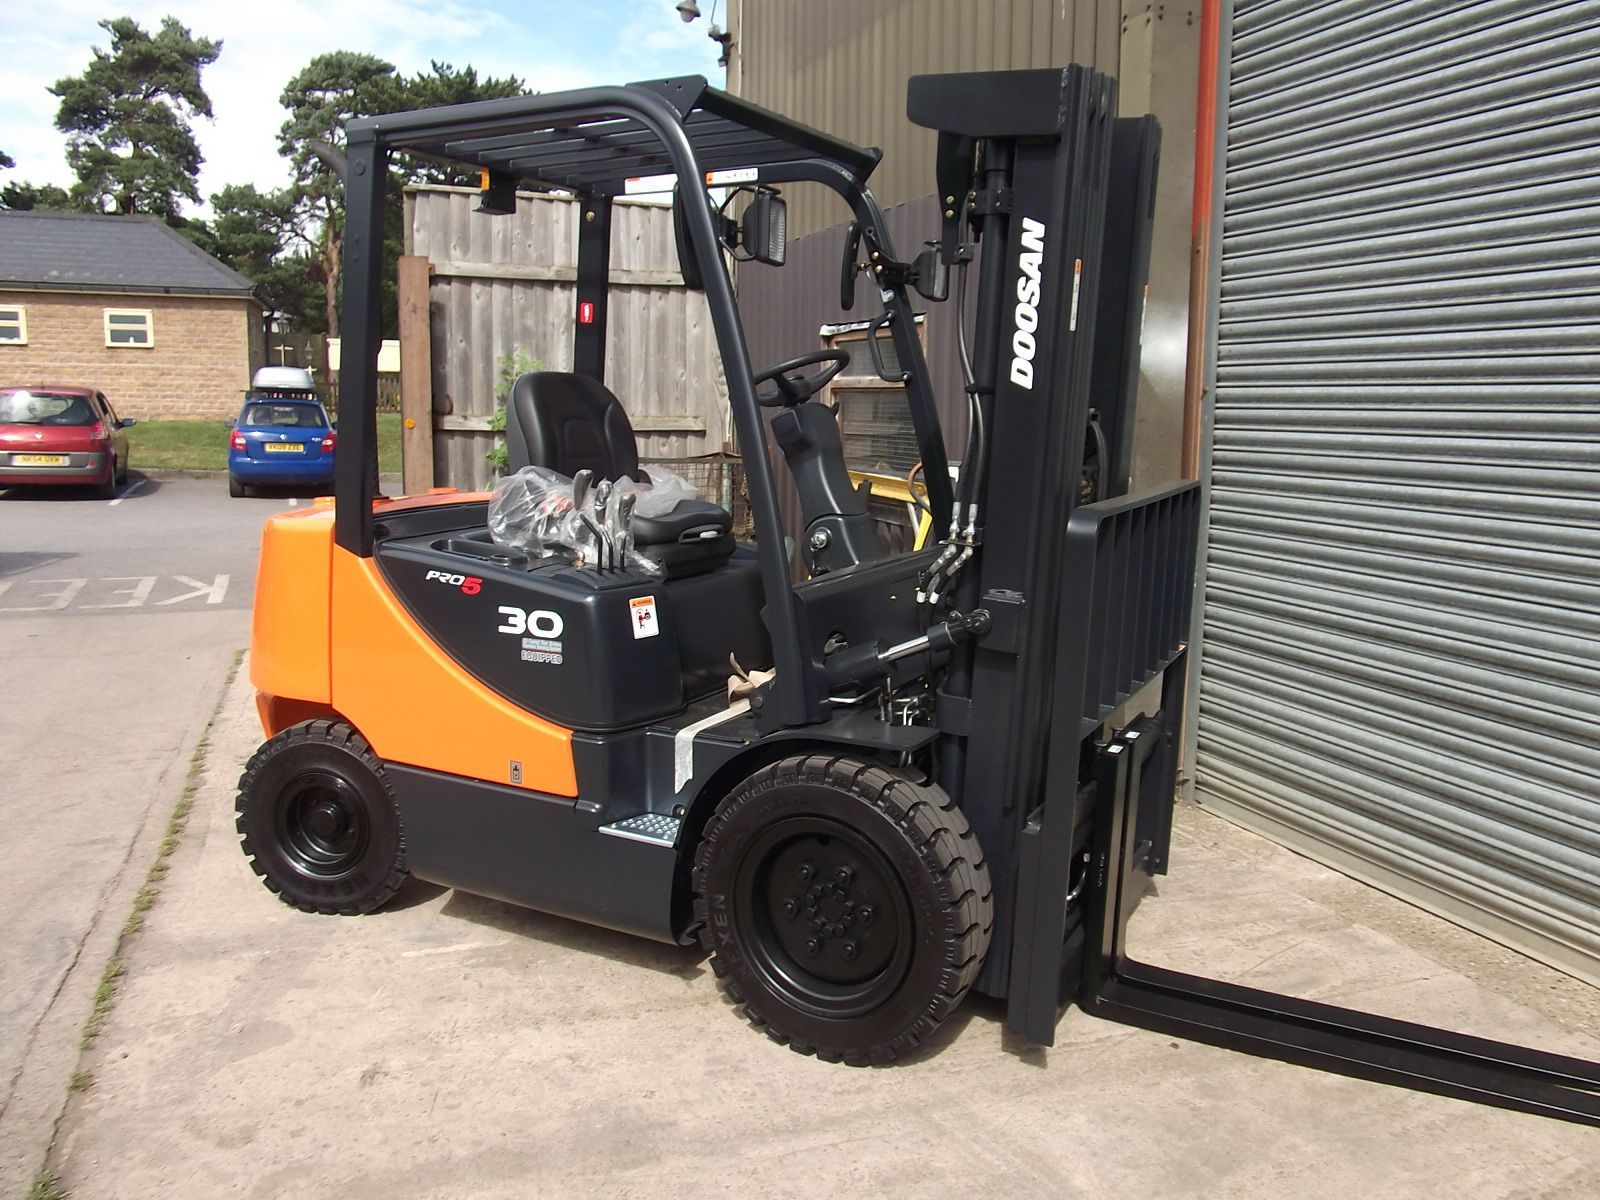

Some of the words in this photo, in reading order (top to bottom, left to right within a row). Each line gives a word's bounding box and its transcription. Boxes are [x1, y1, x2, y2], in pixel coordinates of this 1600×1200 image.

[1010, 217, 1046, 390] DOOSAN
[0, 574, 231, 611] KEE
[425, 570, 483, 595] PRO5
[498, 605, 564, 639] 30
[521, 651, 563, 664] EQUIPPED
